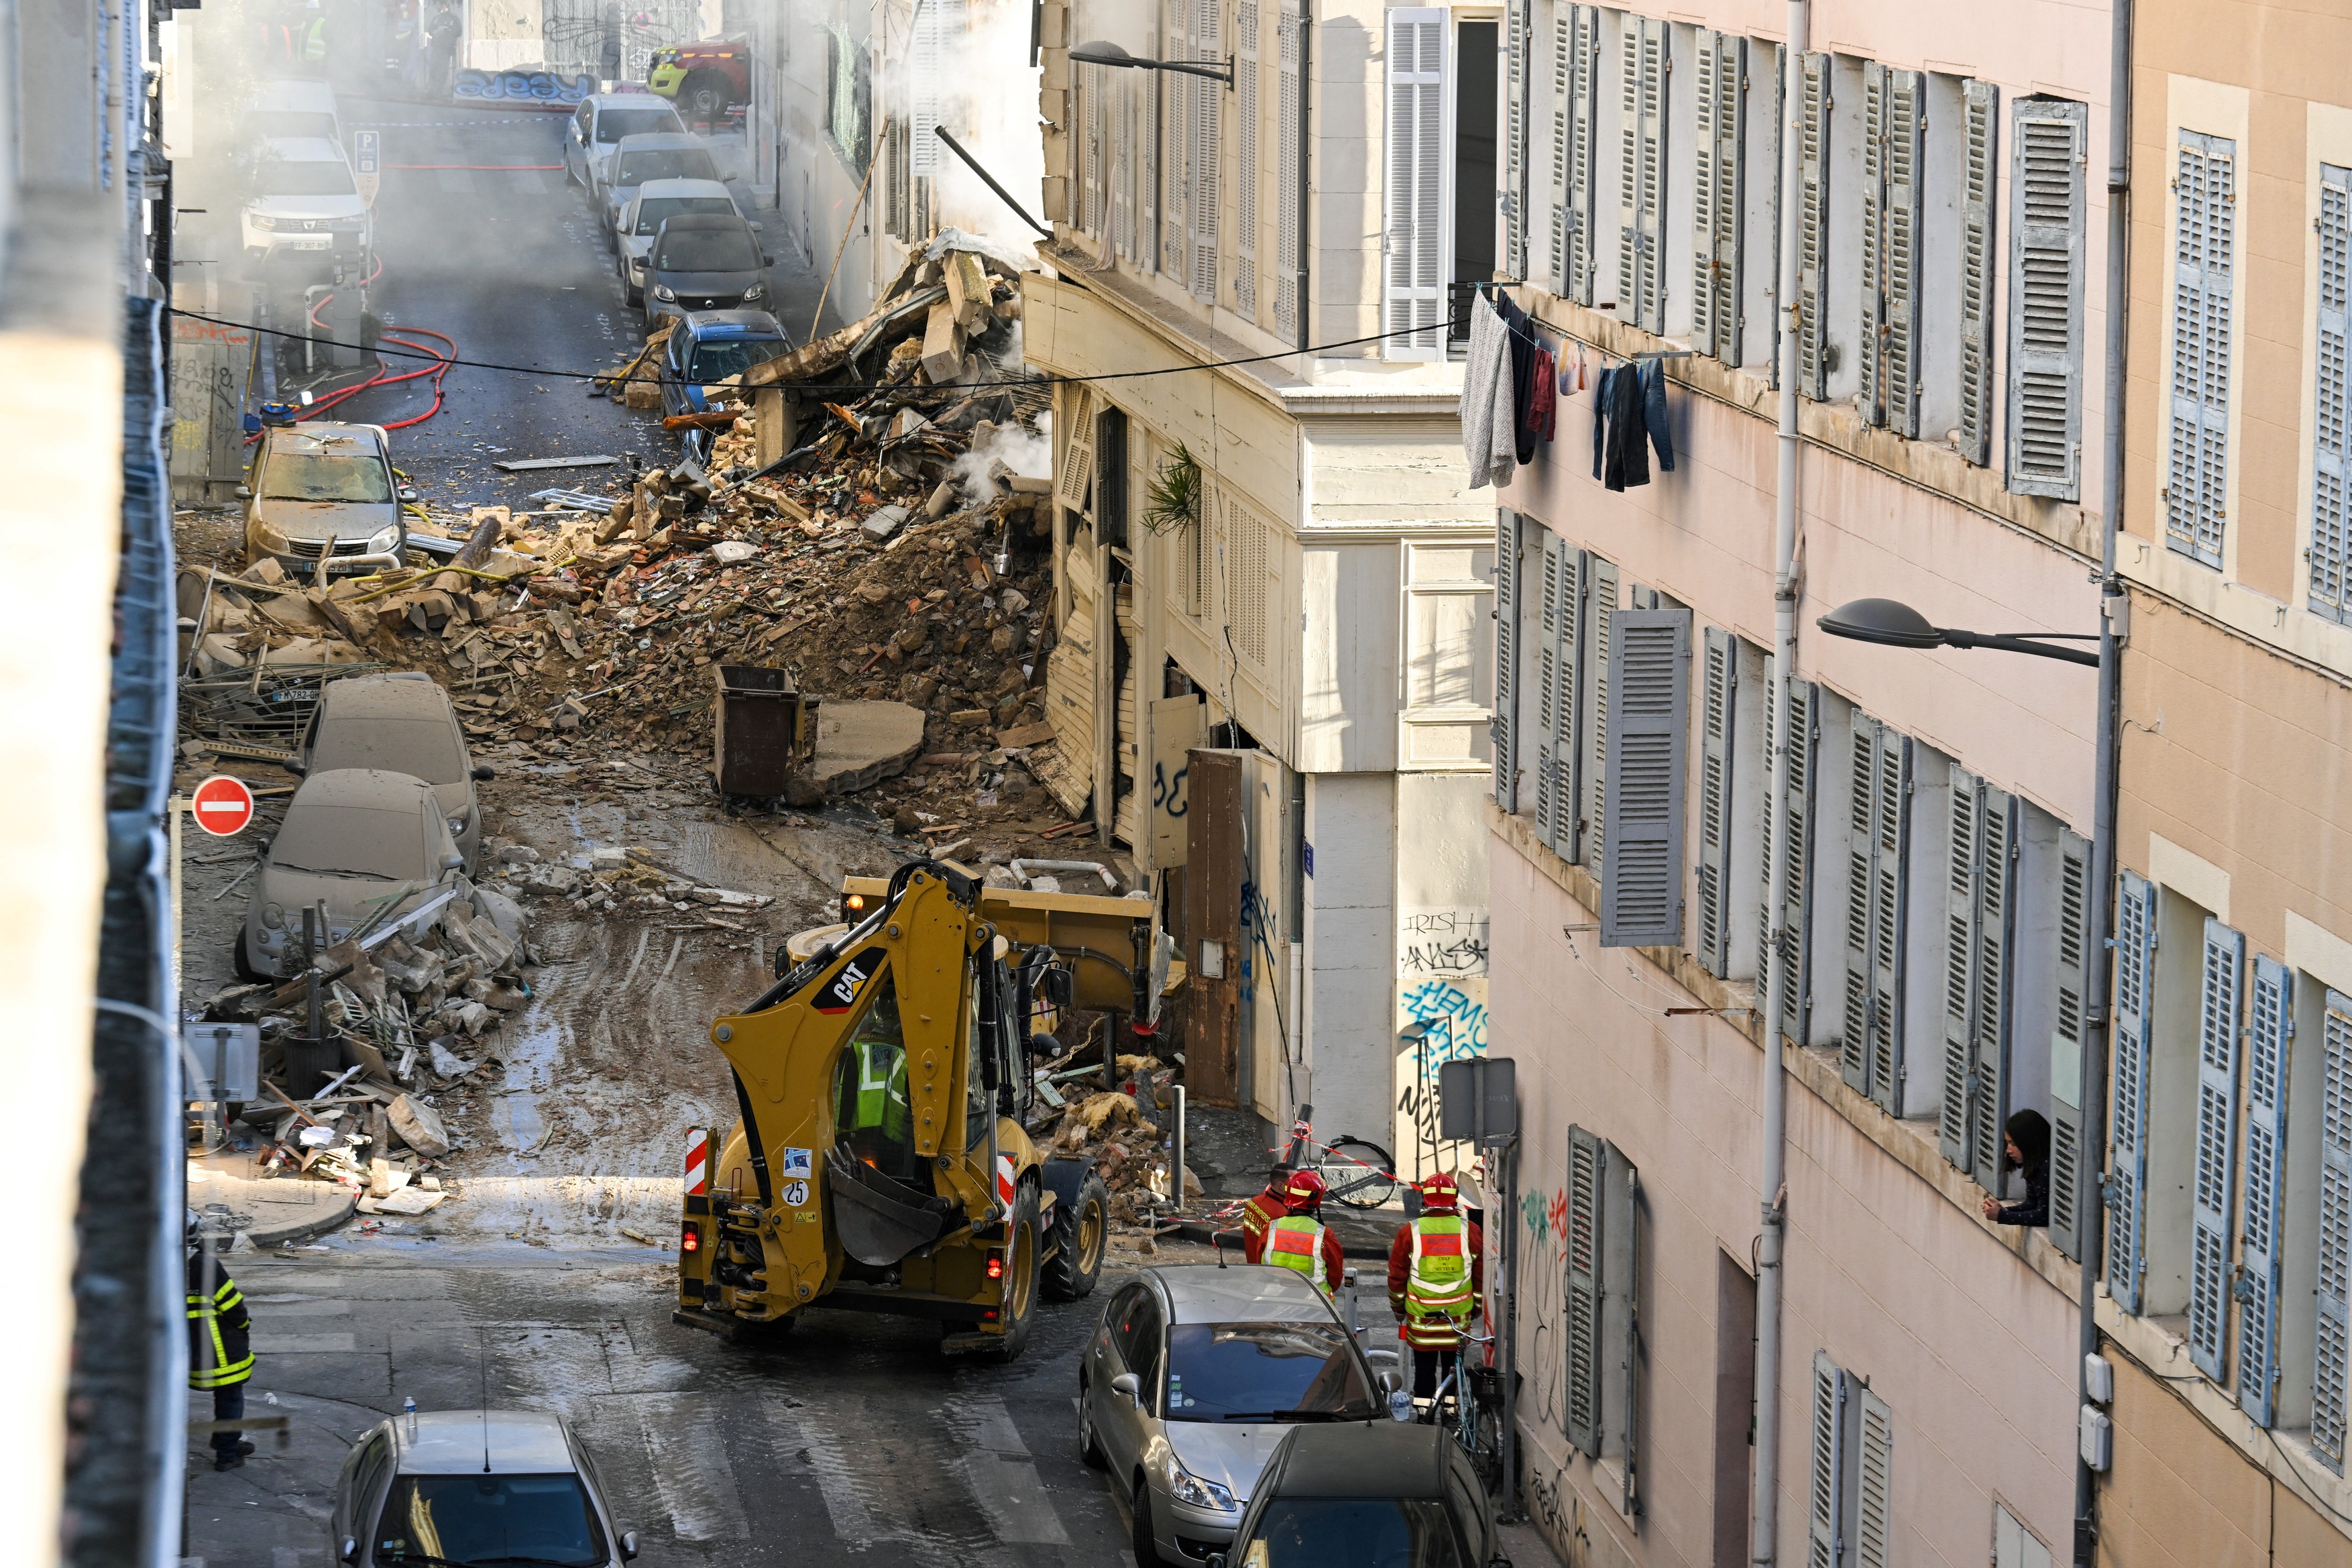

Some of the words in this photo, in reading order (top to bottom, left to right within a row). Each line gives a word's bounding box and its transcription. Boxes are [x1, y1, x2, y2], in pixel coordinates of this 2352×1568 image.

[363, 133, 372, 147] P
[1402, 911, 1490, 936] IRISH
[834, 962, 867, 1003] CAT
[787, 1181, 803, 1204] 25
